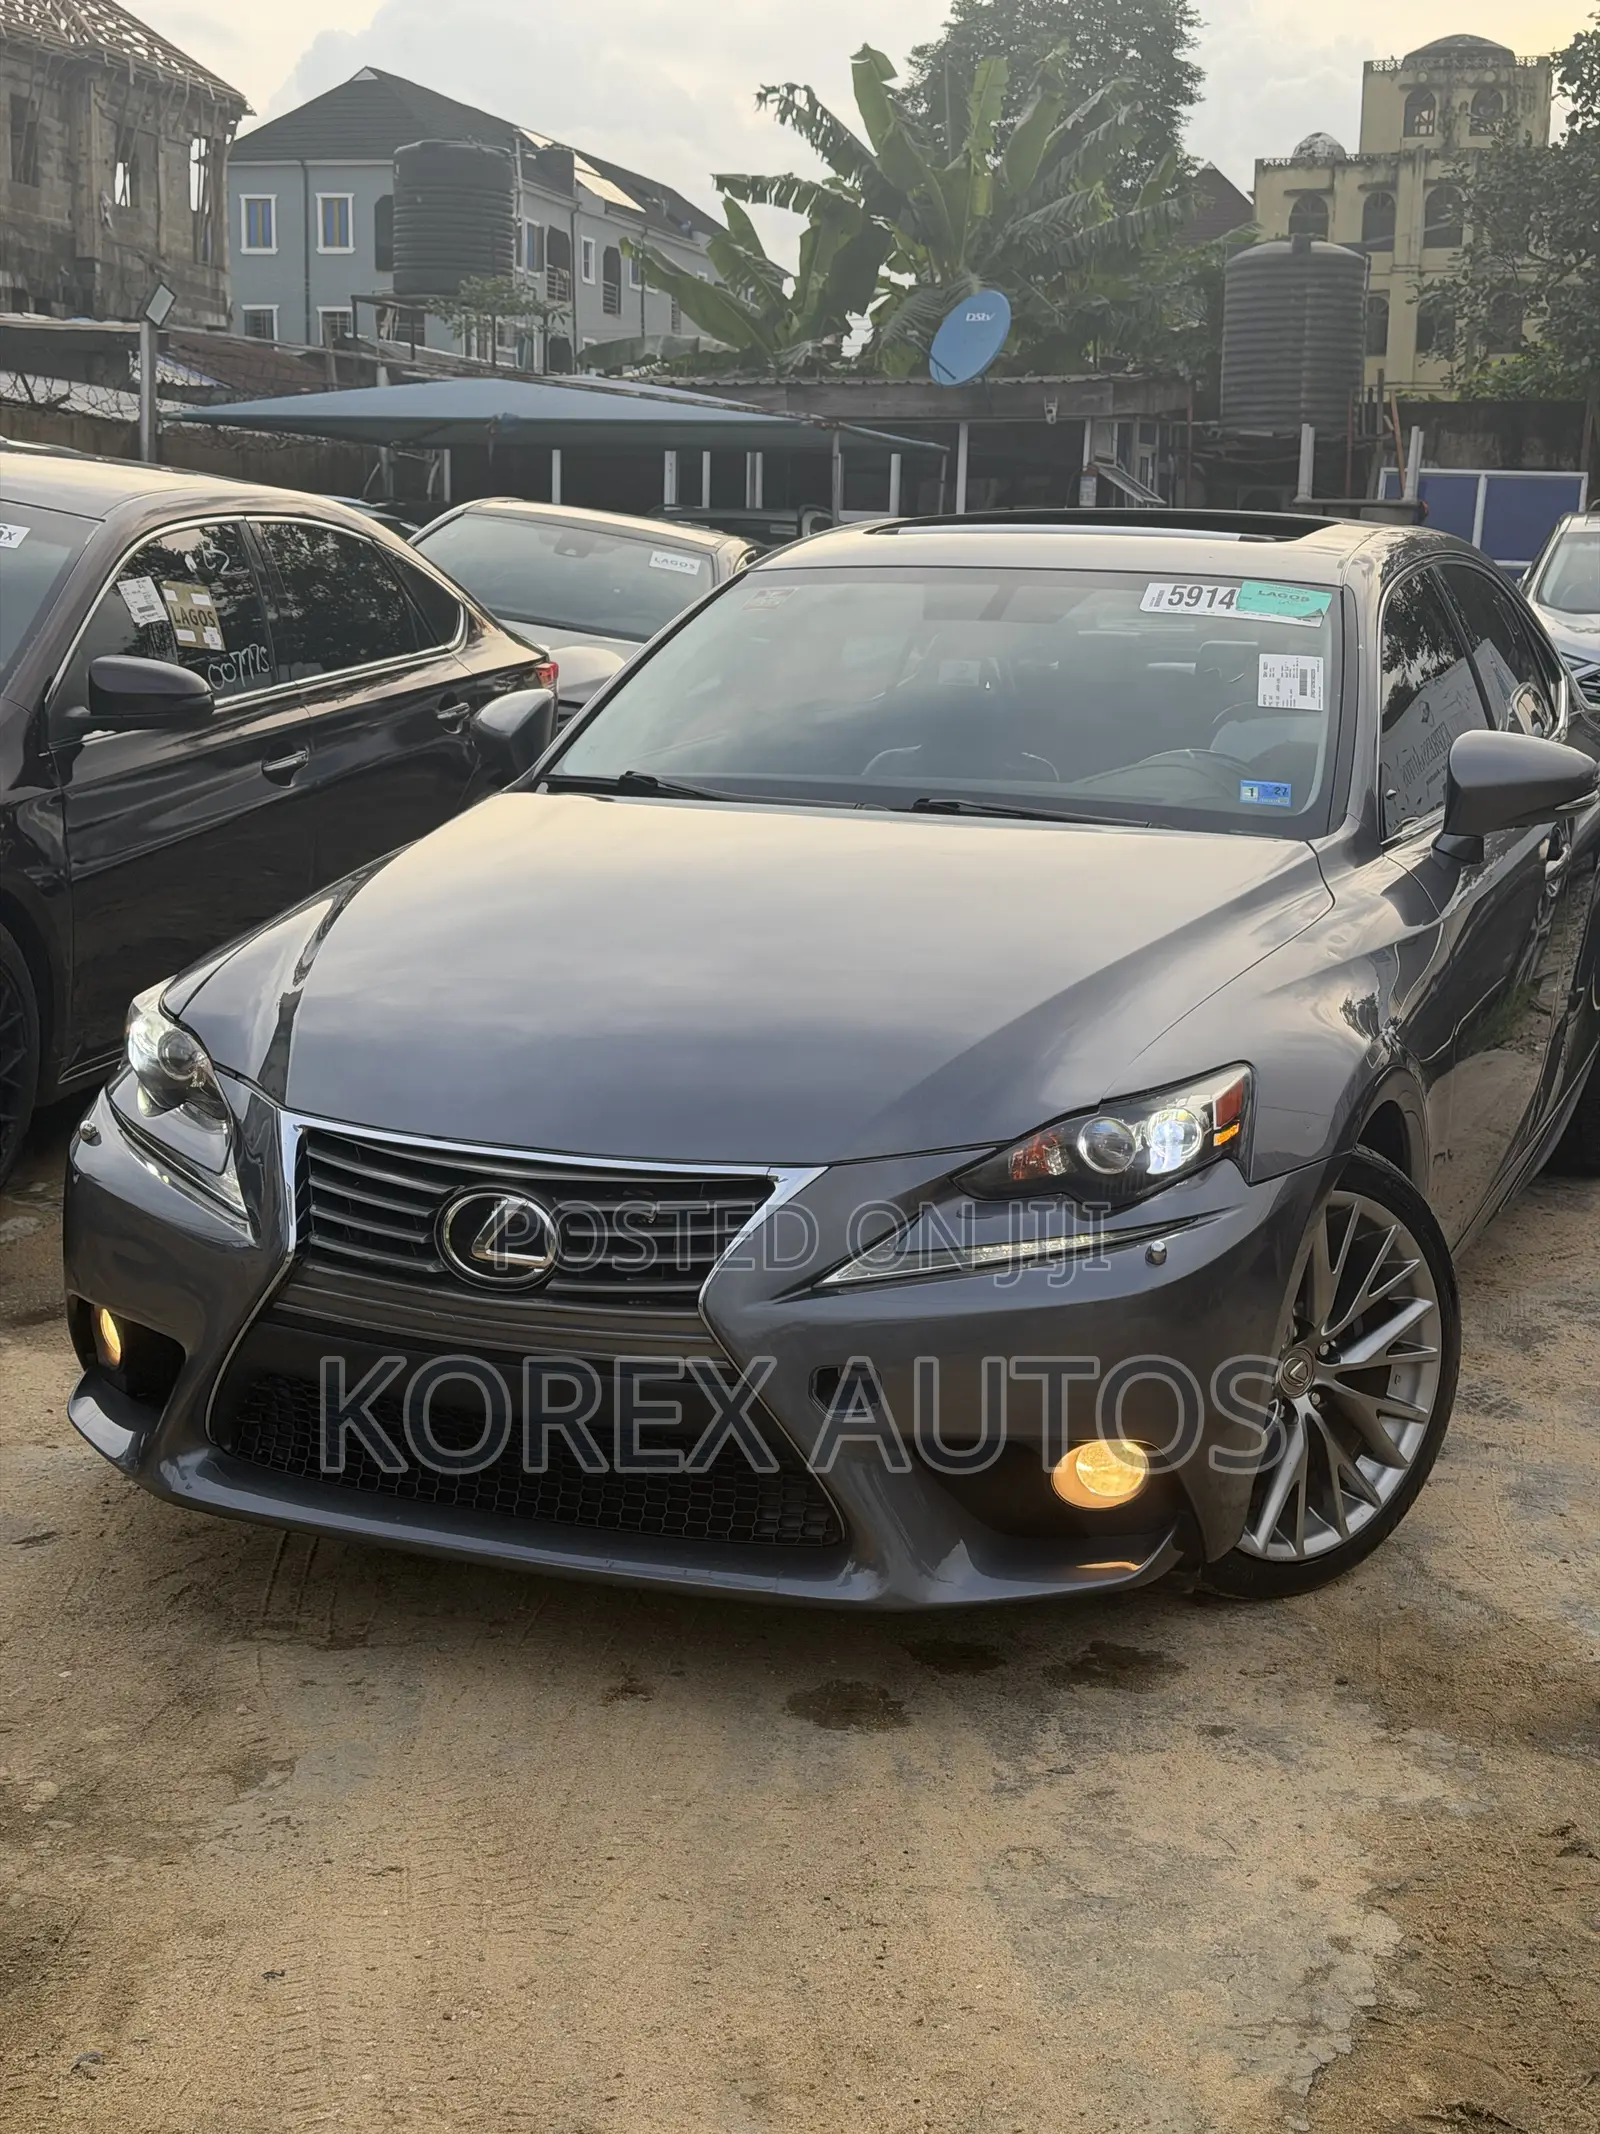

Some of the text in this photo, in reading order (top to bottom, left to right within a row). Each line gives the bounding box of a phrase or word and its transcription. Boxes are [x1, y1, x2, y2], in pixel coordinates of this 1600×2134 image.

[654, 556, 696, 570] LAGOS
[1167, 584, 1237, 610] 5914
[1258, 589, 1311, 603] LAGOS
[171, 605, 216, 628] LAGOS
[1248, 787, 1254, 797] 1
